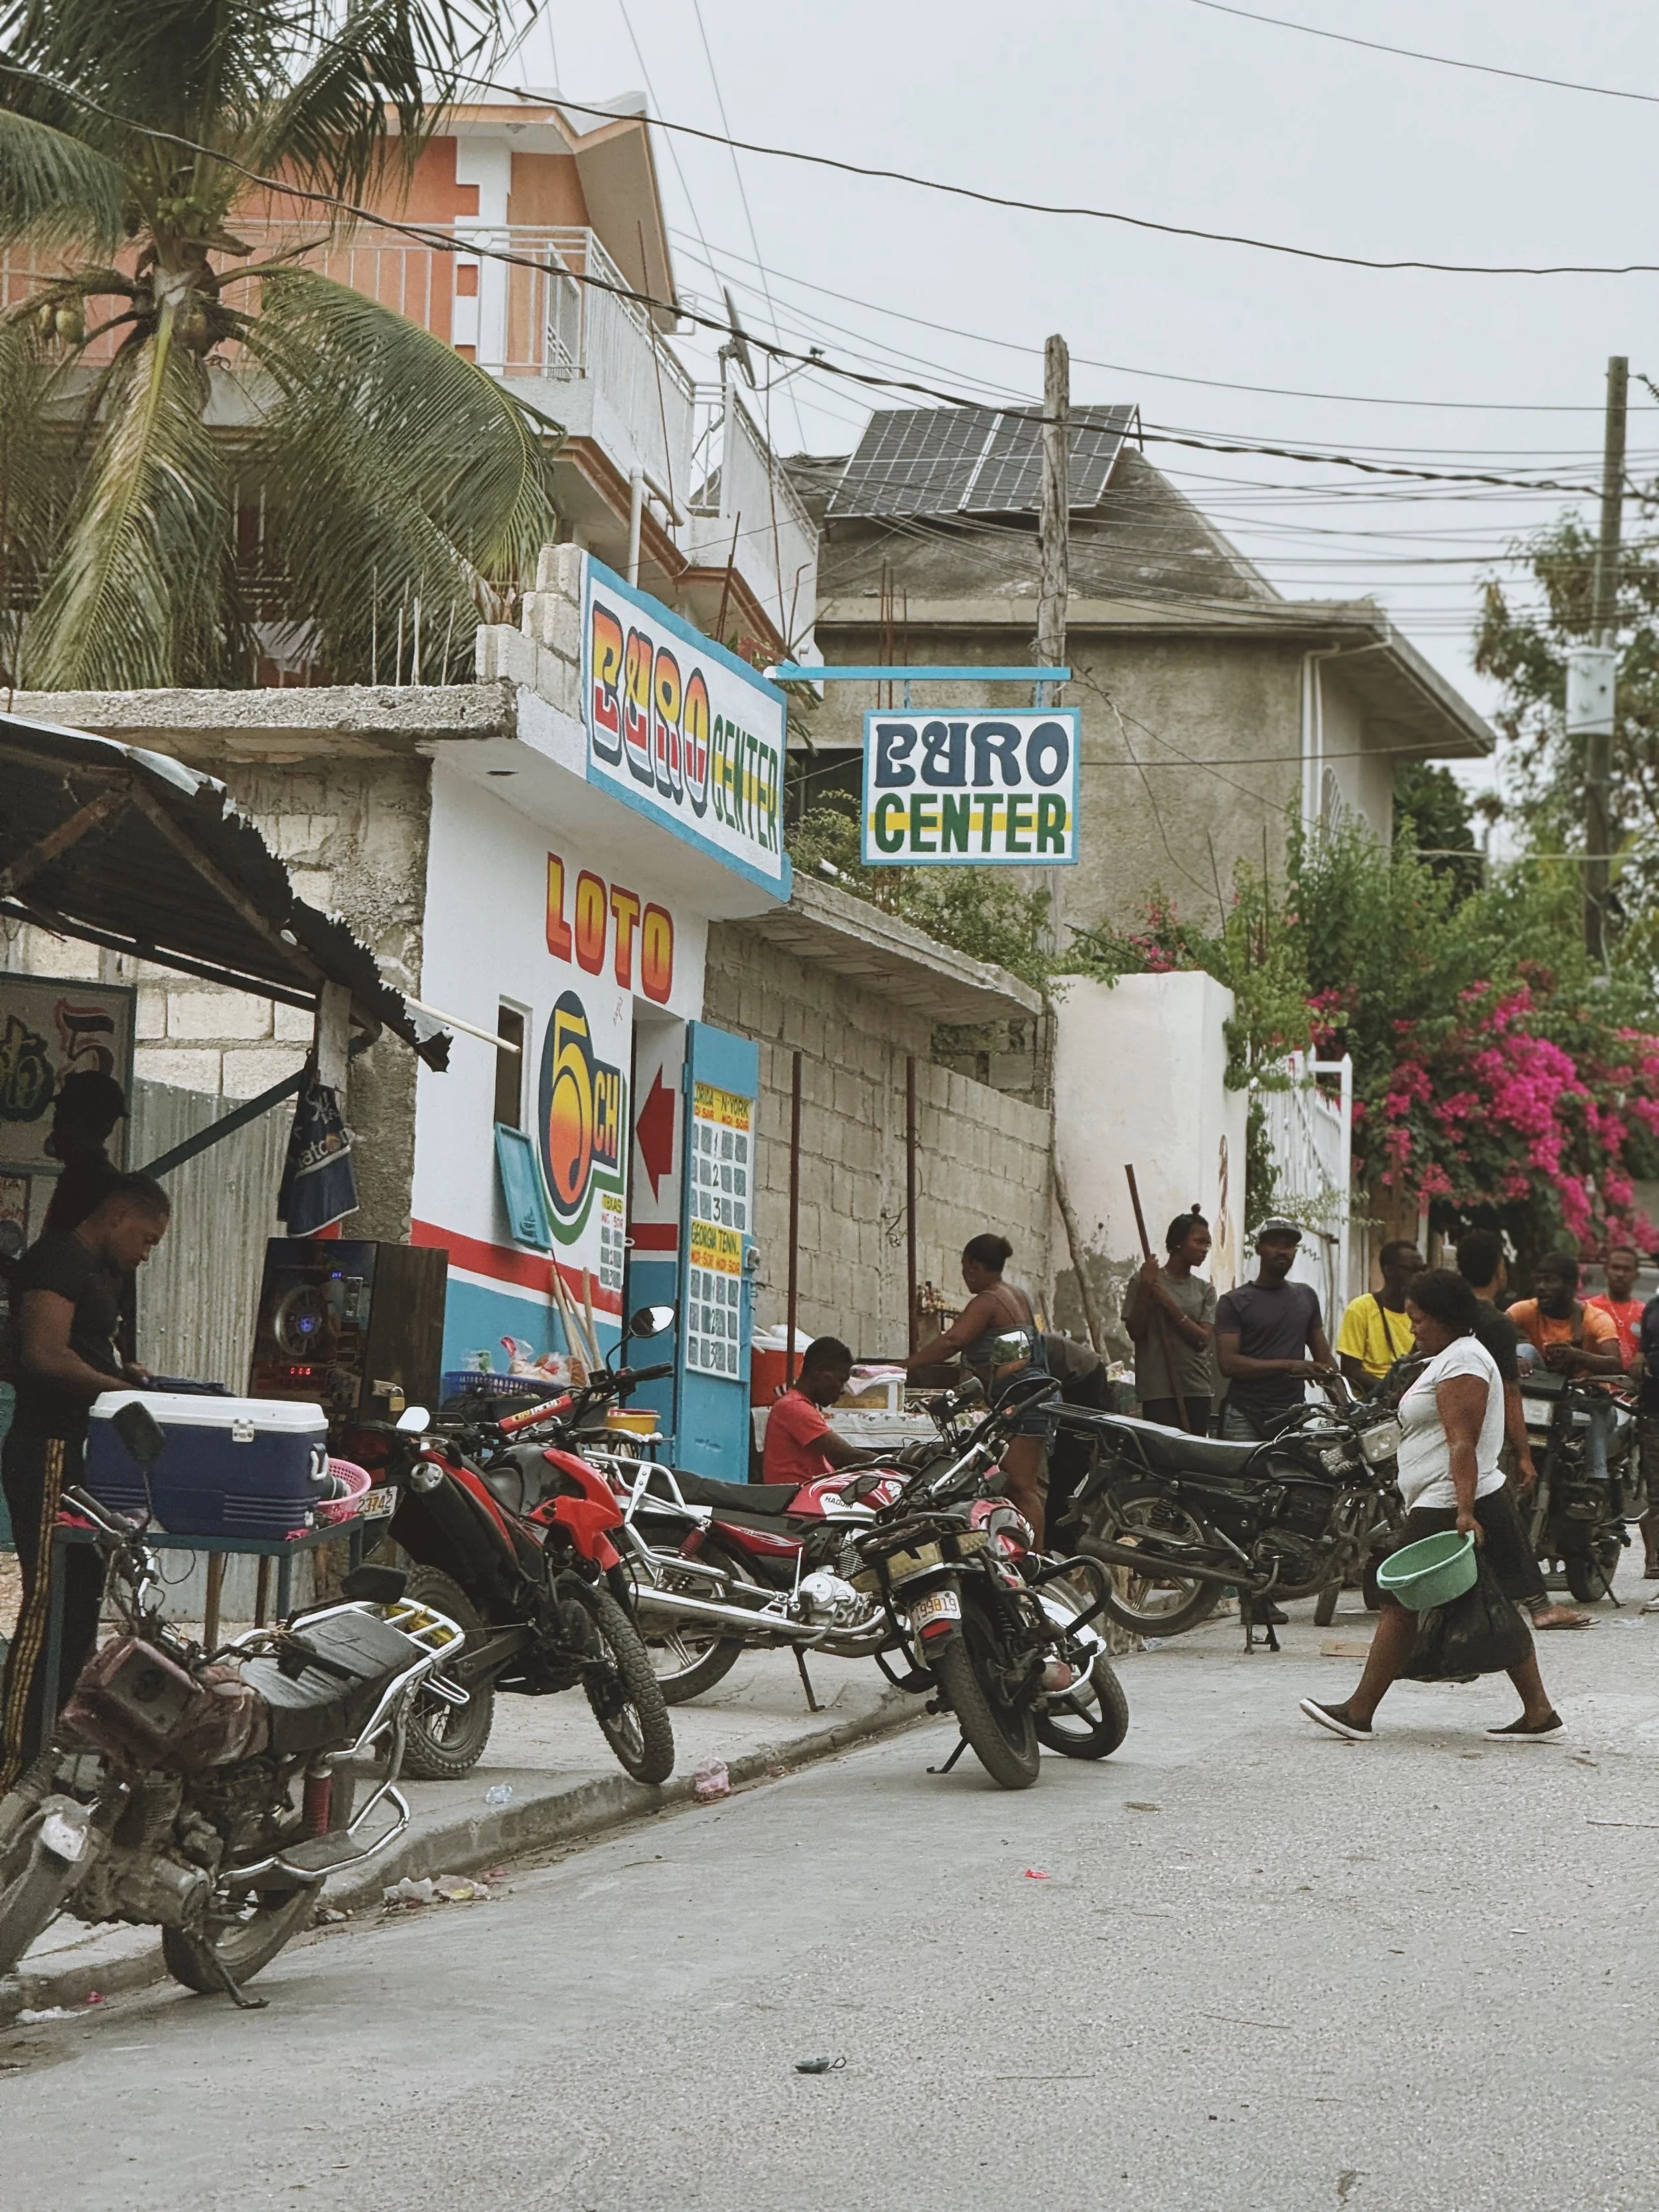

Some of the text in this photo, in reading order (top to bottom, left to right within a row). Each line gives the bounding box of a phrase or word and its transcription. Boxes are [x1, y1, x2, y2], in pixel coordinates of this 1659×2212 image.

[711, 713, 778, 854] CENTER
[874, 792, 1067, 854] CENTER
[546, 851, 674, 1005] LOTO
[713, 1164, 719, 1187] 2
[713, 1197, 721, 1221] 3
